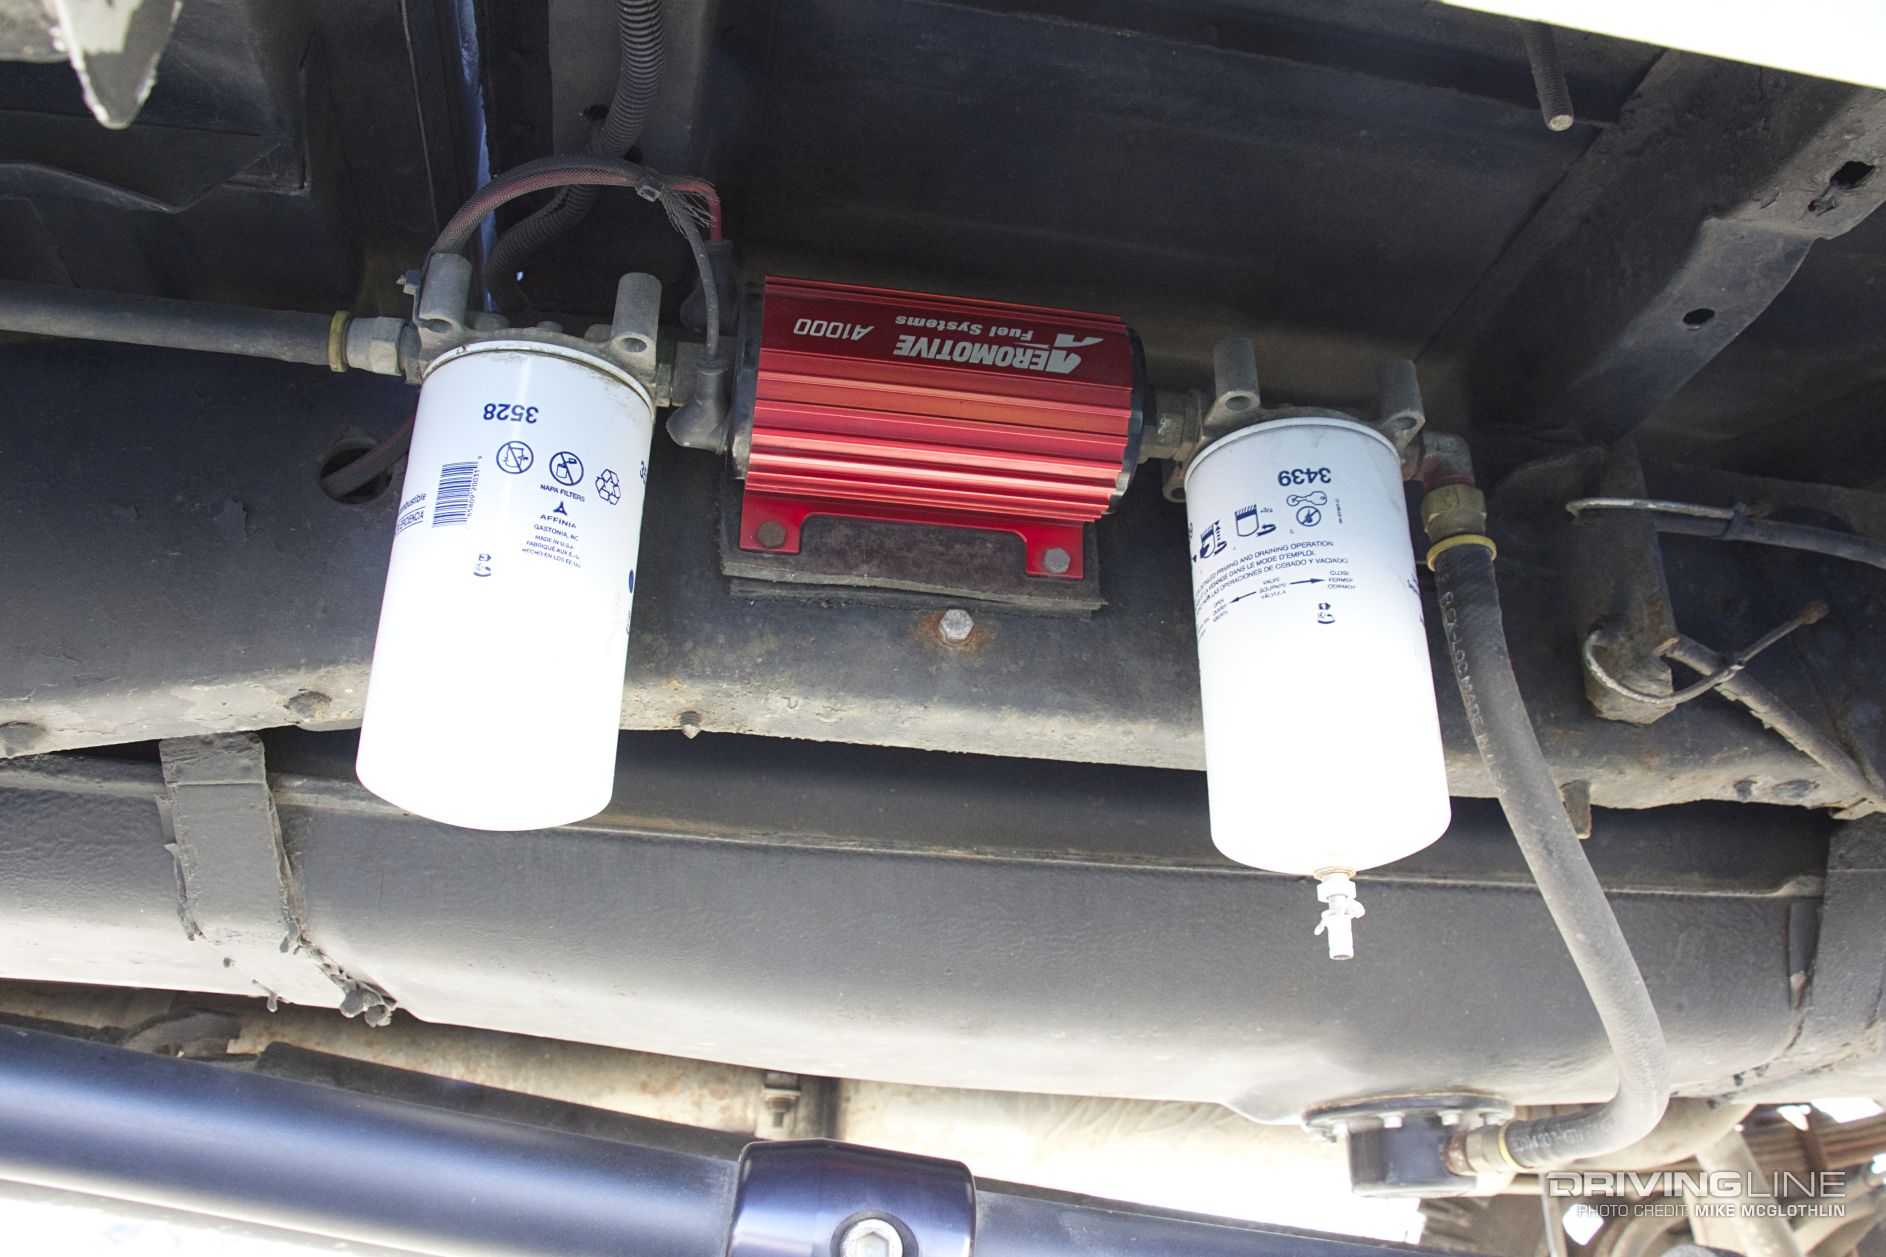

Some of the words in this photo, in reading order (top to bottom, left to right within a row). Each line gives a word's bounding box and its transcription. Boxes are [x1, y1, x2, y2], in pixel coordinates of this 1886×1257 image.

[793, 318, 875, 341] A1000
[895, 315, 982, 335] Systems
[989, 327, 1034, 341] Fuel
[893, 334, 1103, 374] AEROMOTIVE
[483, 403, 539, 424] 3528
[1277, 467, 1332, 487] 3439
[540, 484, 559, 494] NAPA
[560, 488, 585, 502] FILTERS
[540, 514, 577, 529] AFFINIA
[535, 535, 552, 543] MADE
[1239, 554, 1253, 564] AND
[1254, 545, 1289, 558] DRAINING
[1290, 541, 1334, 550] OPERATION
[1220, 568, 1262, 591] OPERACIONES
[1263, 565, 1274, 573] DE
[1275, 559, 1307, 569] CEBADO
[1229, 566, 1245, 578] DANS
[1246, 562, 1255, 570] LE
[1256, 555, 1277, 566] MODE
[1460, 675, 1485, 727] MADE
